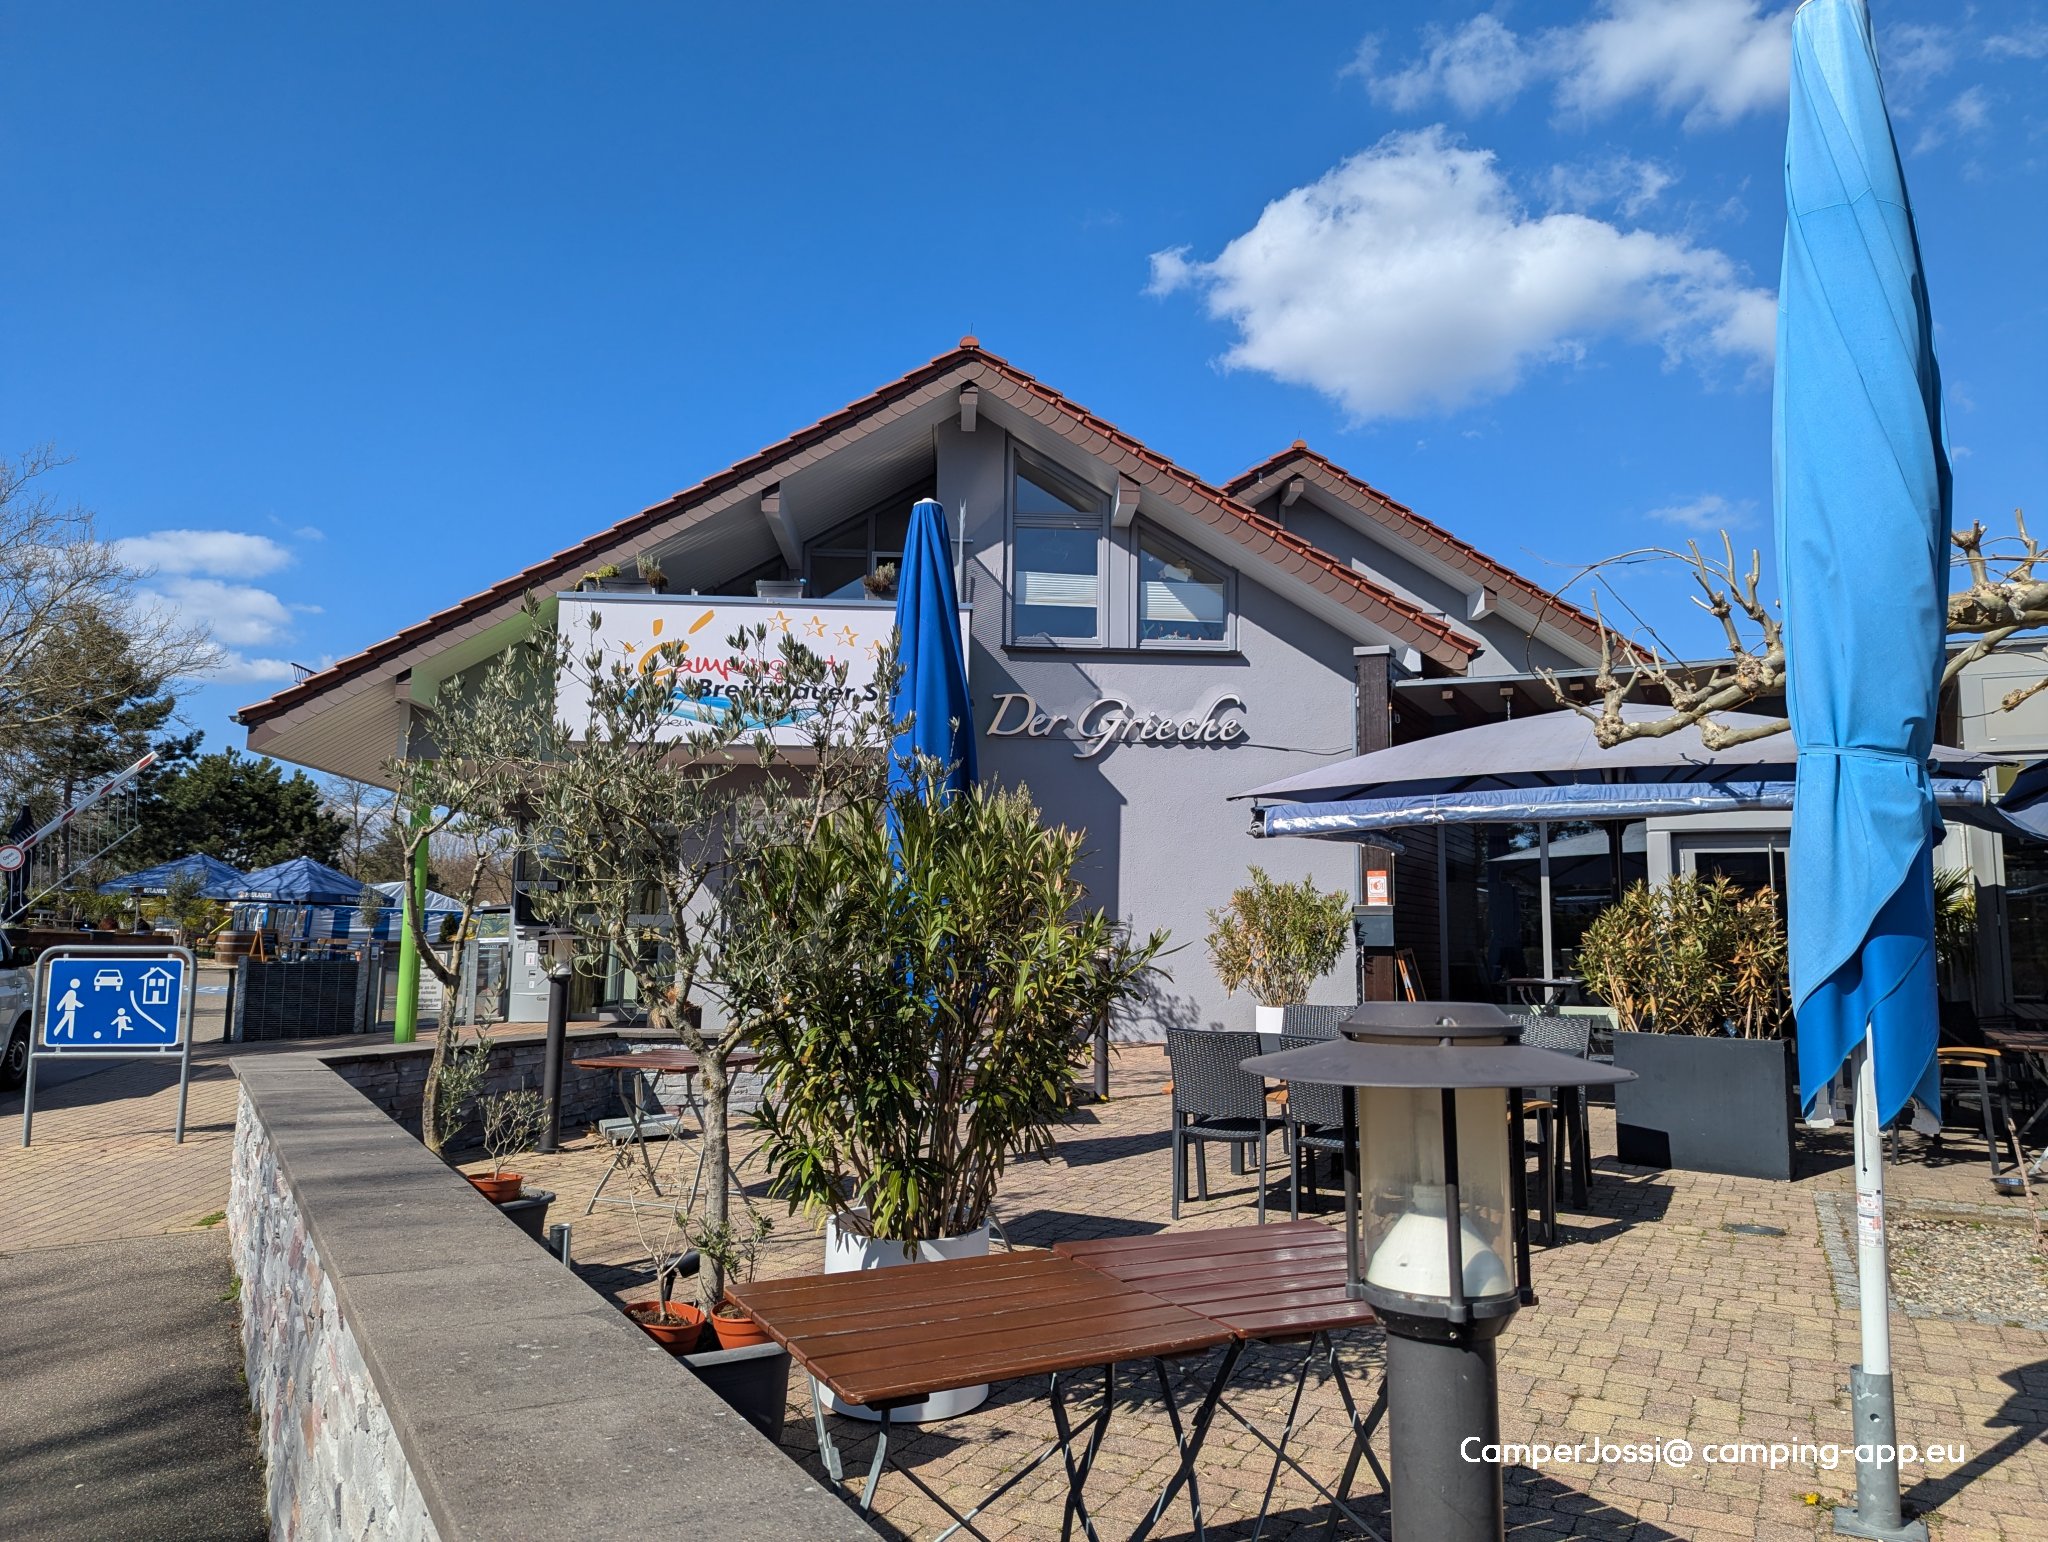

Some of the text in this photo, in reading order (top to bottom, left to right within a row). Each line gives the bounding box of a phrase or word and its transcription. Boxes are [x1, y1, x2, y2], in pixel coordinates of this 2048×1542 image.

[697, 679, 856, 702] Breiteauer
[986, 693, 1245, 759] Der Grieche
